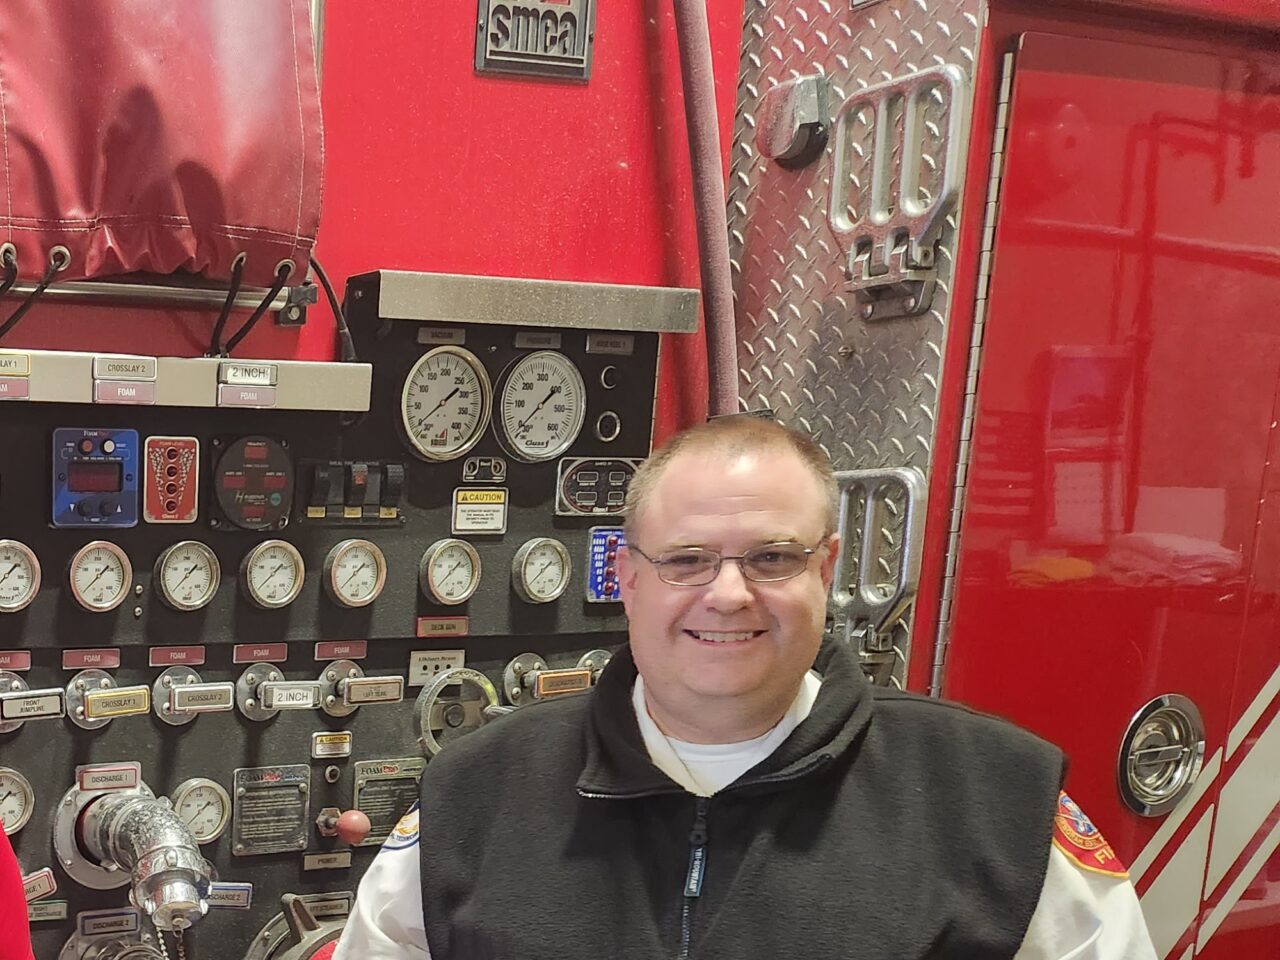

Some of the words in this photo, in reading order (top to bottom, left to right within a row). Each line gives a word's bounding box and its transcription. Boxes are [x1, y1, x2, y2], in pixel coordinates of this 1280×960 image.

[107, 364, 140, 373] CROSSLAY
[232, 367, 238, 377] 2
[241, 368, 266, 378] INCH
[440, 368, 451, 376] 200
[428, 372, 438, 381] 150
[454, 376, 465, 385] 250
[537, 373, 548, 382] 300
[419, 385, 429, 393] 100
[522, 382, 534, 390] 200
[118, 387, 136, 396] FOAM
[459, 390, 470, 398] 300
[240, 392, 257, 400] FOAM
[414, 402, 421, 410] 50
[515, 400, 525, 408] 100
[458, 407, 469, 415] 350
[554, 404, 565, 413] 500
[451, 422, 462, 431] 400
[547, 423, 559, 431] 600
[469, 493, 502, 501] CAUTION
[254, 649, 269, 657] FOAM
[334, 646, 350, 654] FOAM
[188, 694, 217, 702] CROSSLAY
[286, 692, 308, 702] INCH
[101, 699, 131, 708] CROSSLAY
[91, 775, 123, 783] DISCHARGE
[93, 921, 122, 930] DISCHARGE
